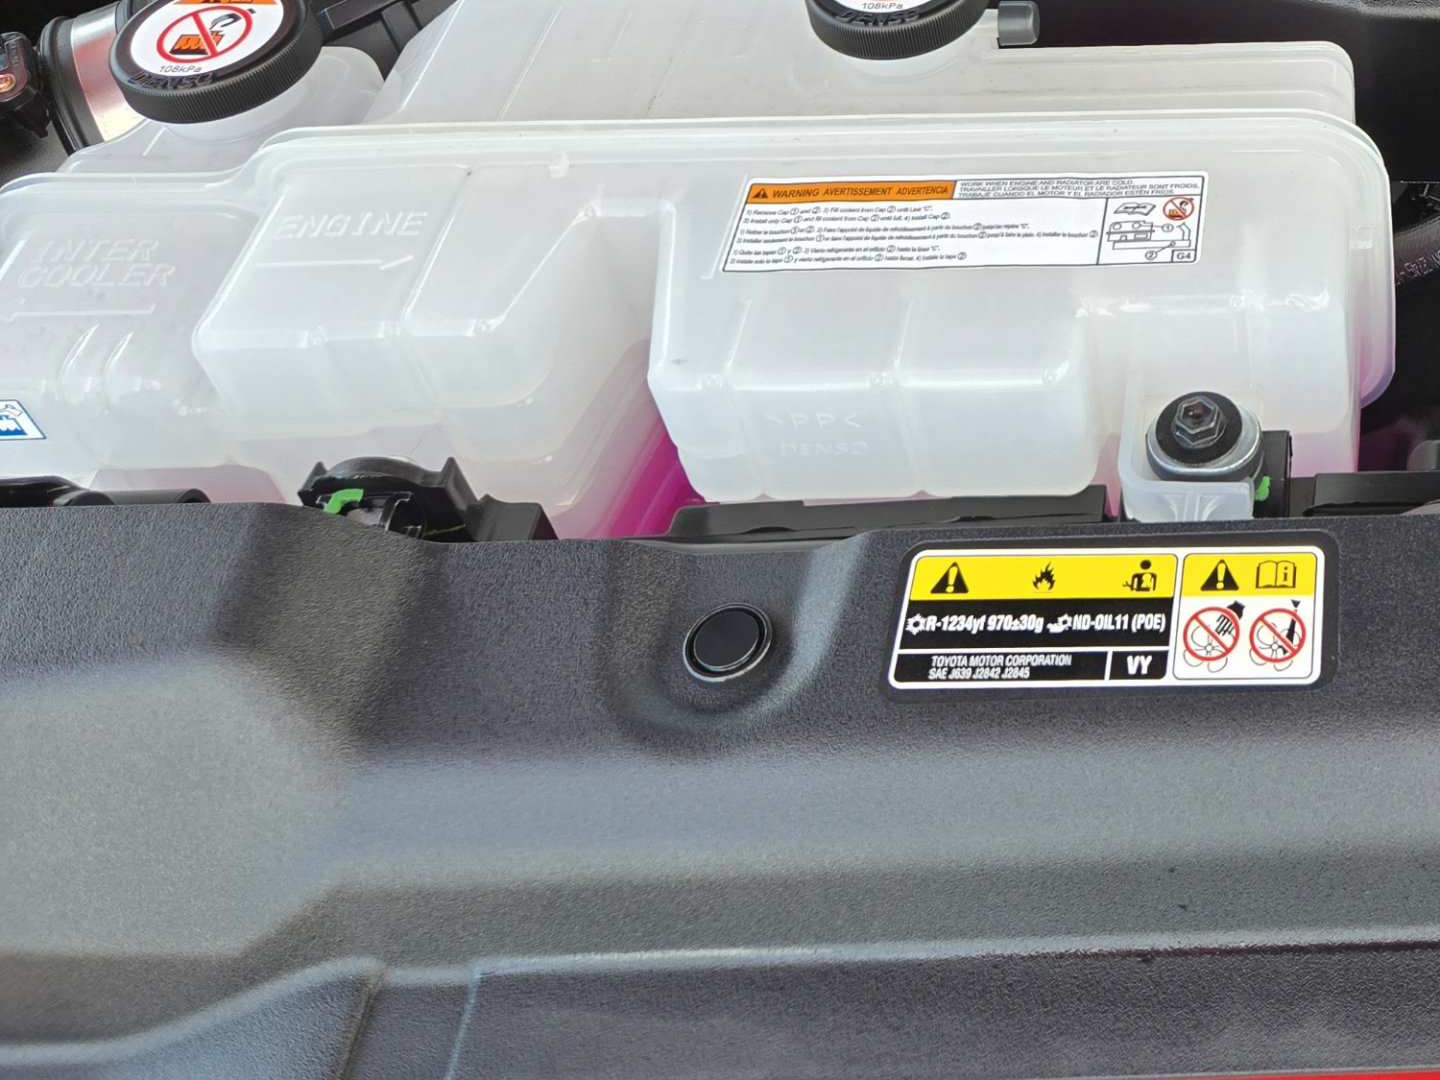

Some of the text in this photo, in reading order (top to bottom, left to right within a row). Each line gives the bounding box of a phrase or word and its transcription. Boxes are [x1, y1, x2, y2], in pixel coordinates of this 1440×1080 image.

[772, 185, 949, 198] WARNING AVERTISSEMENT ADVERTENCIA
[272, 211, 428, 239] ENGINE
[32, 239, 160, 265] INTER
[1176, 252, 1191, 260] G4
[18, 263, 176, 289] COOLER
[925, 613, 1166, 634] R-1234yf 970±30g ND-OIL11 (POE)
[931, 654, 1072, 667] TOYOTA MOTOR CORPORATION
[1126, 655, 1152, 675] VY
[928, 667, 1030, 679] SAE J639 J2842 J2845
